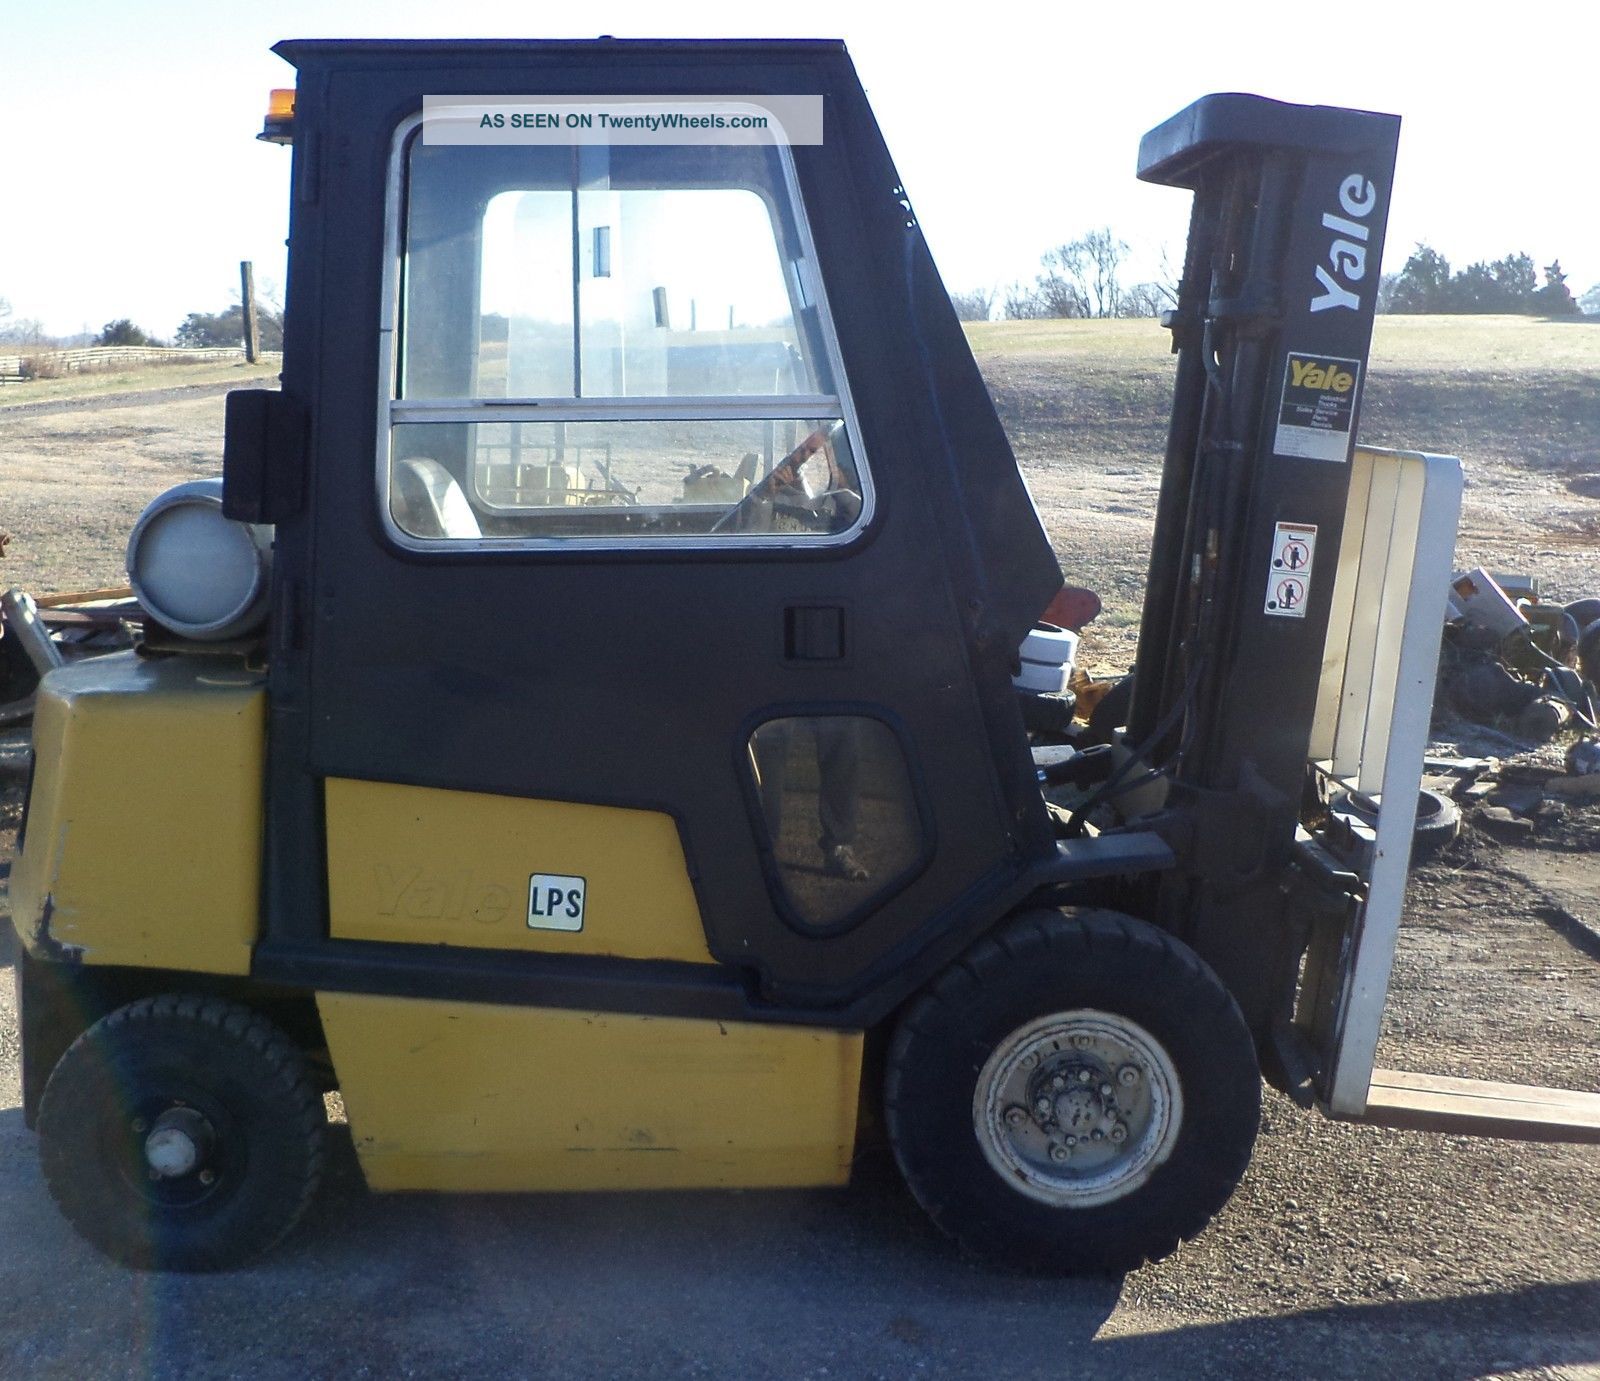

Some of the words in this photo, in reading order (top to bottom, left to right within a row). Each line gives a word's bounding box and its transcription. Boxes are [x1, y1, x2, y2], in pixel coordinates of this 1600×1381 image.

[1310, 173, 1376, 312] Yale
[1291, 360, 1353, 392] Yale
[531, 886, 581, 918] LPS
